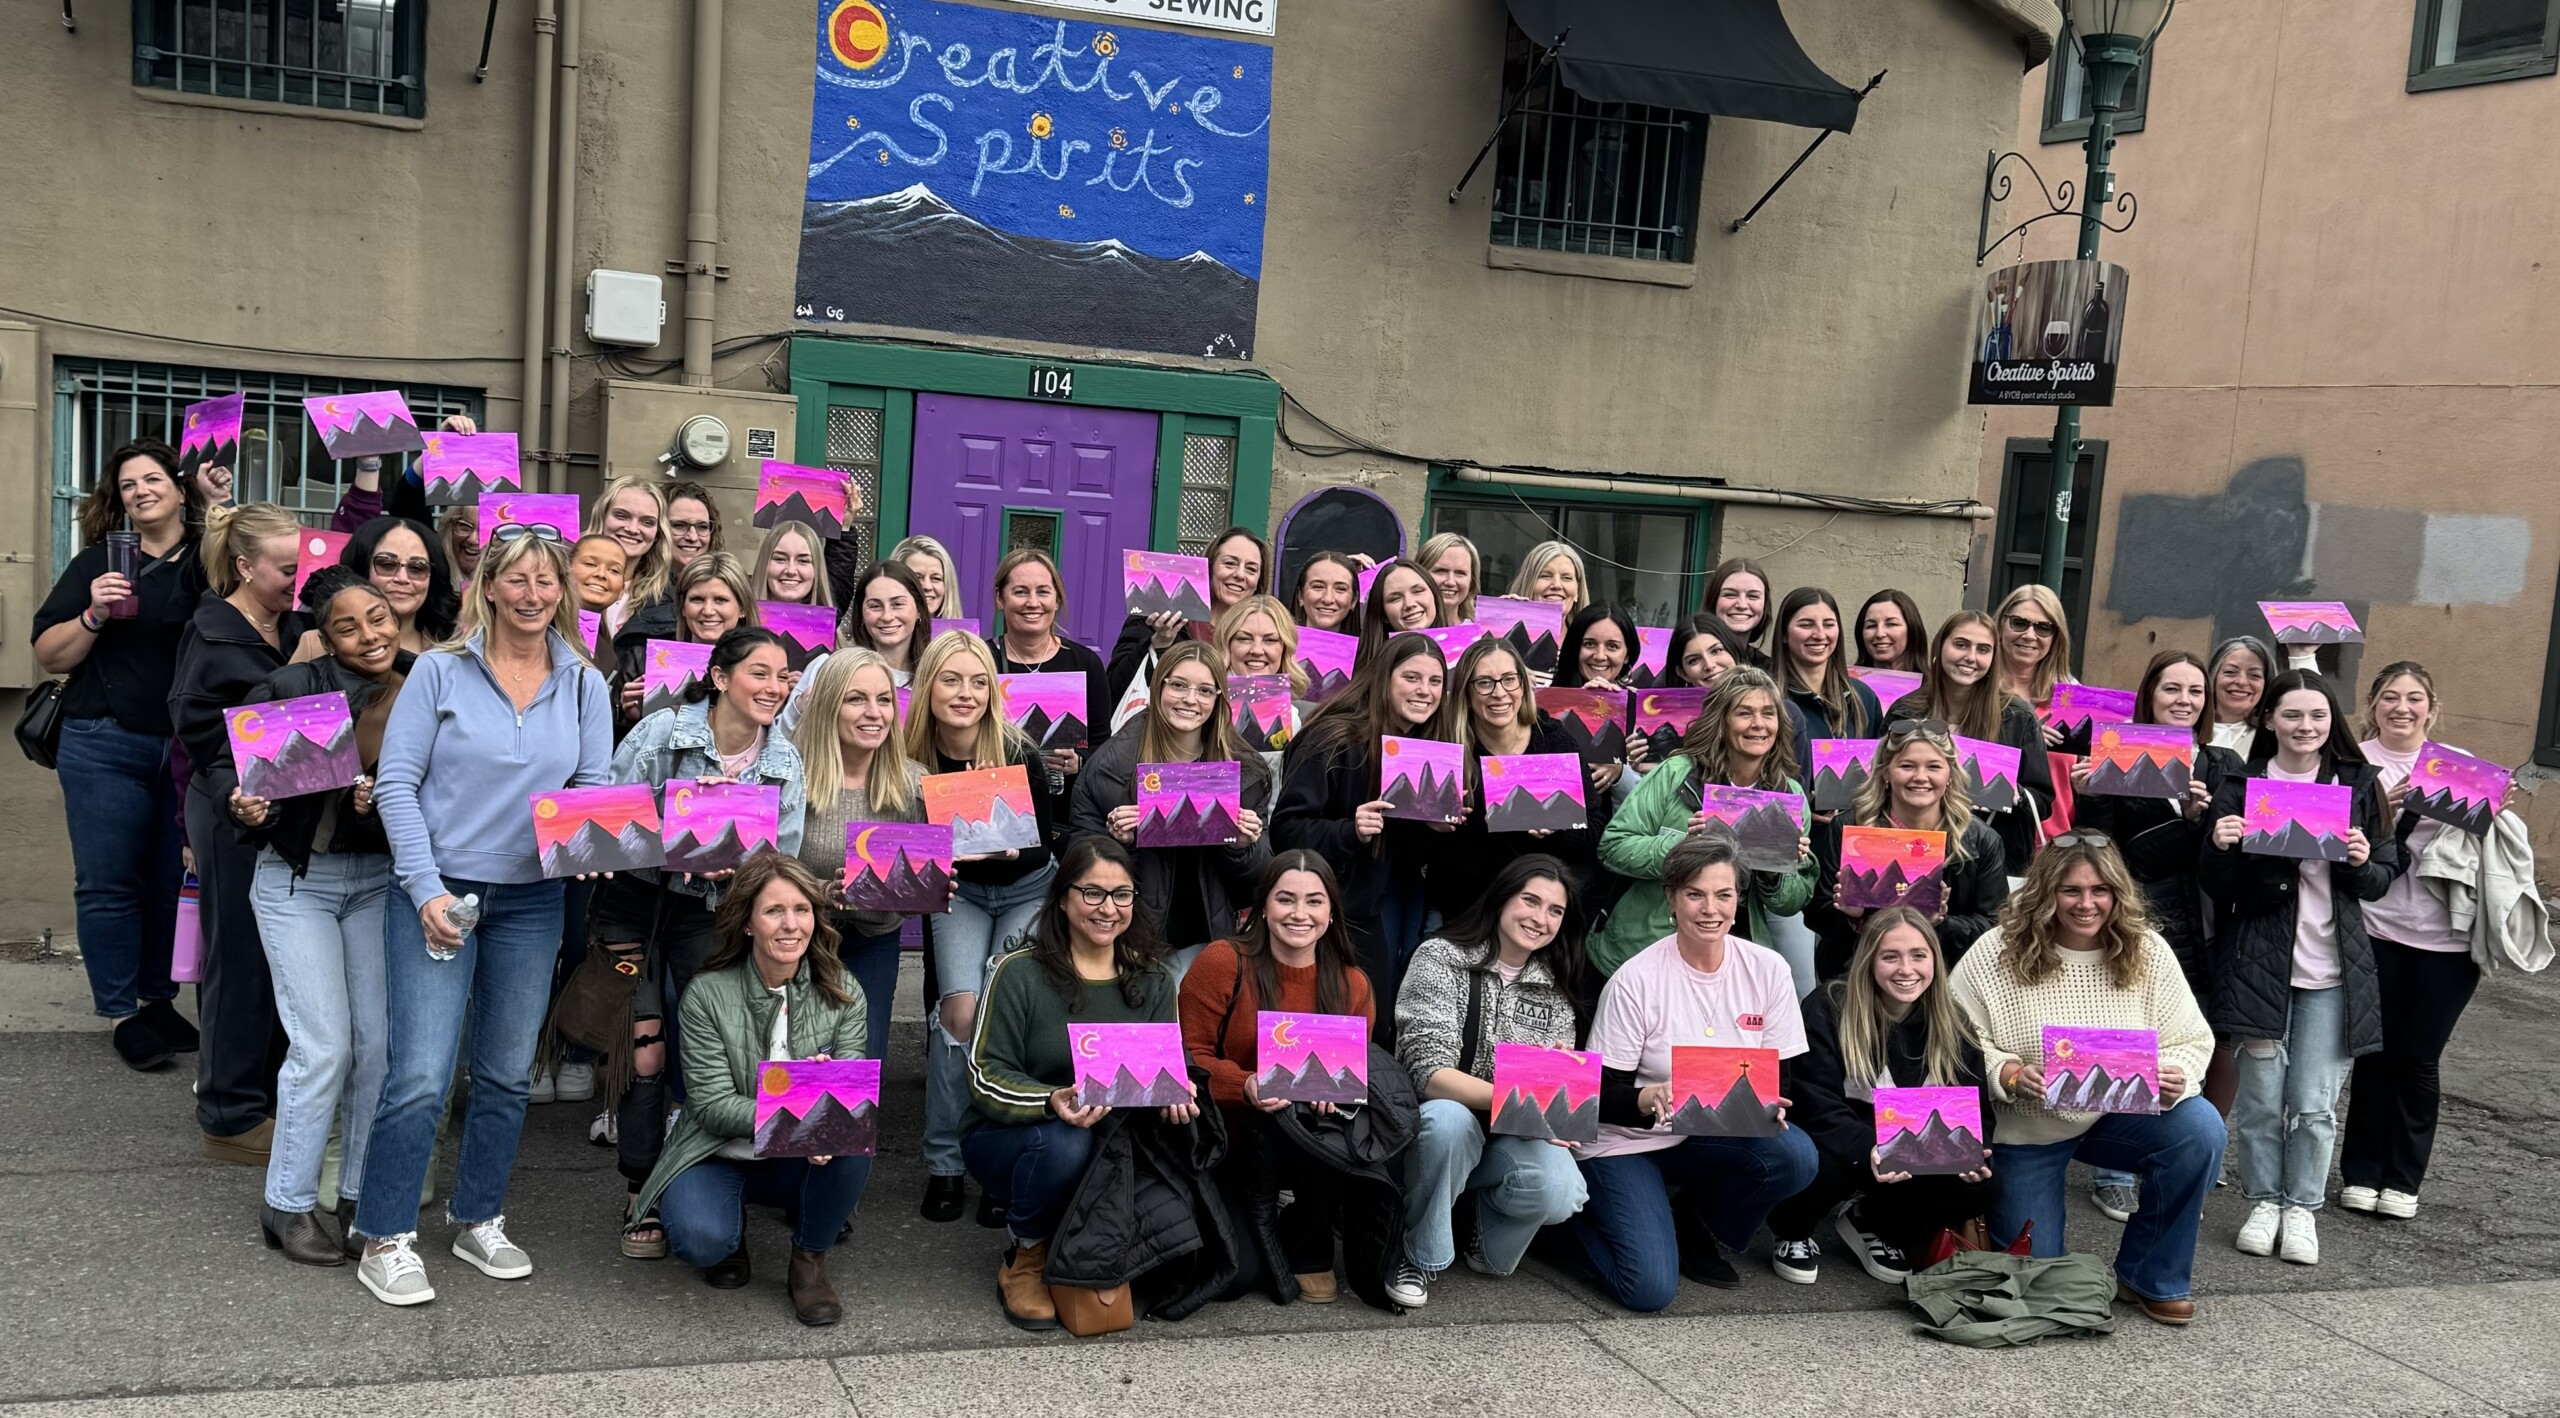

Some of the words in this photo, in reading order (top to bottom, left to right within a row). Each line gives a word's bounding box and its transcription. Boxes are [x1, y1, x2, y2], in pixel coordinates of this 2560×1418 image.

[817, 4, 1271, 137] Creative
[808, 93, 1203, 208] Spirits
[1033, 370, 1072, 396] 104
[1987, 362, 2045, 381] Creative
[2047, 360, 2096, 390] Spirits
[1999, 391, 2004, 399] A
[2005, 391, 2021, 399] BYOB
[2021, 392, 2036, 401] paint
[2036, 391, 2048, 399] and
[2057, 391, 2075, 399] studio
